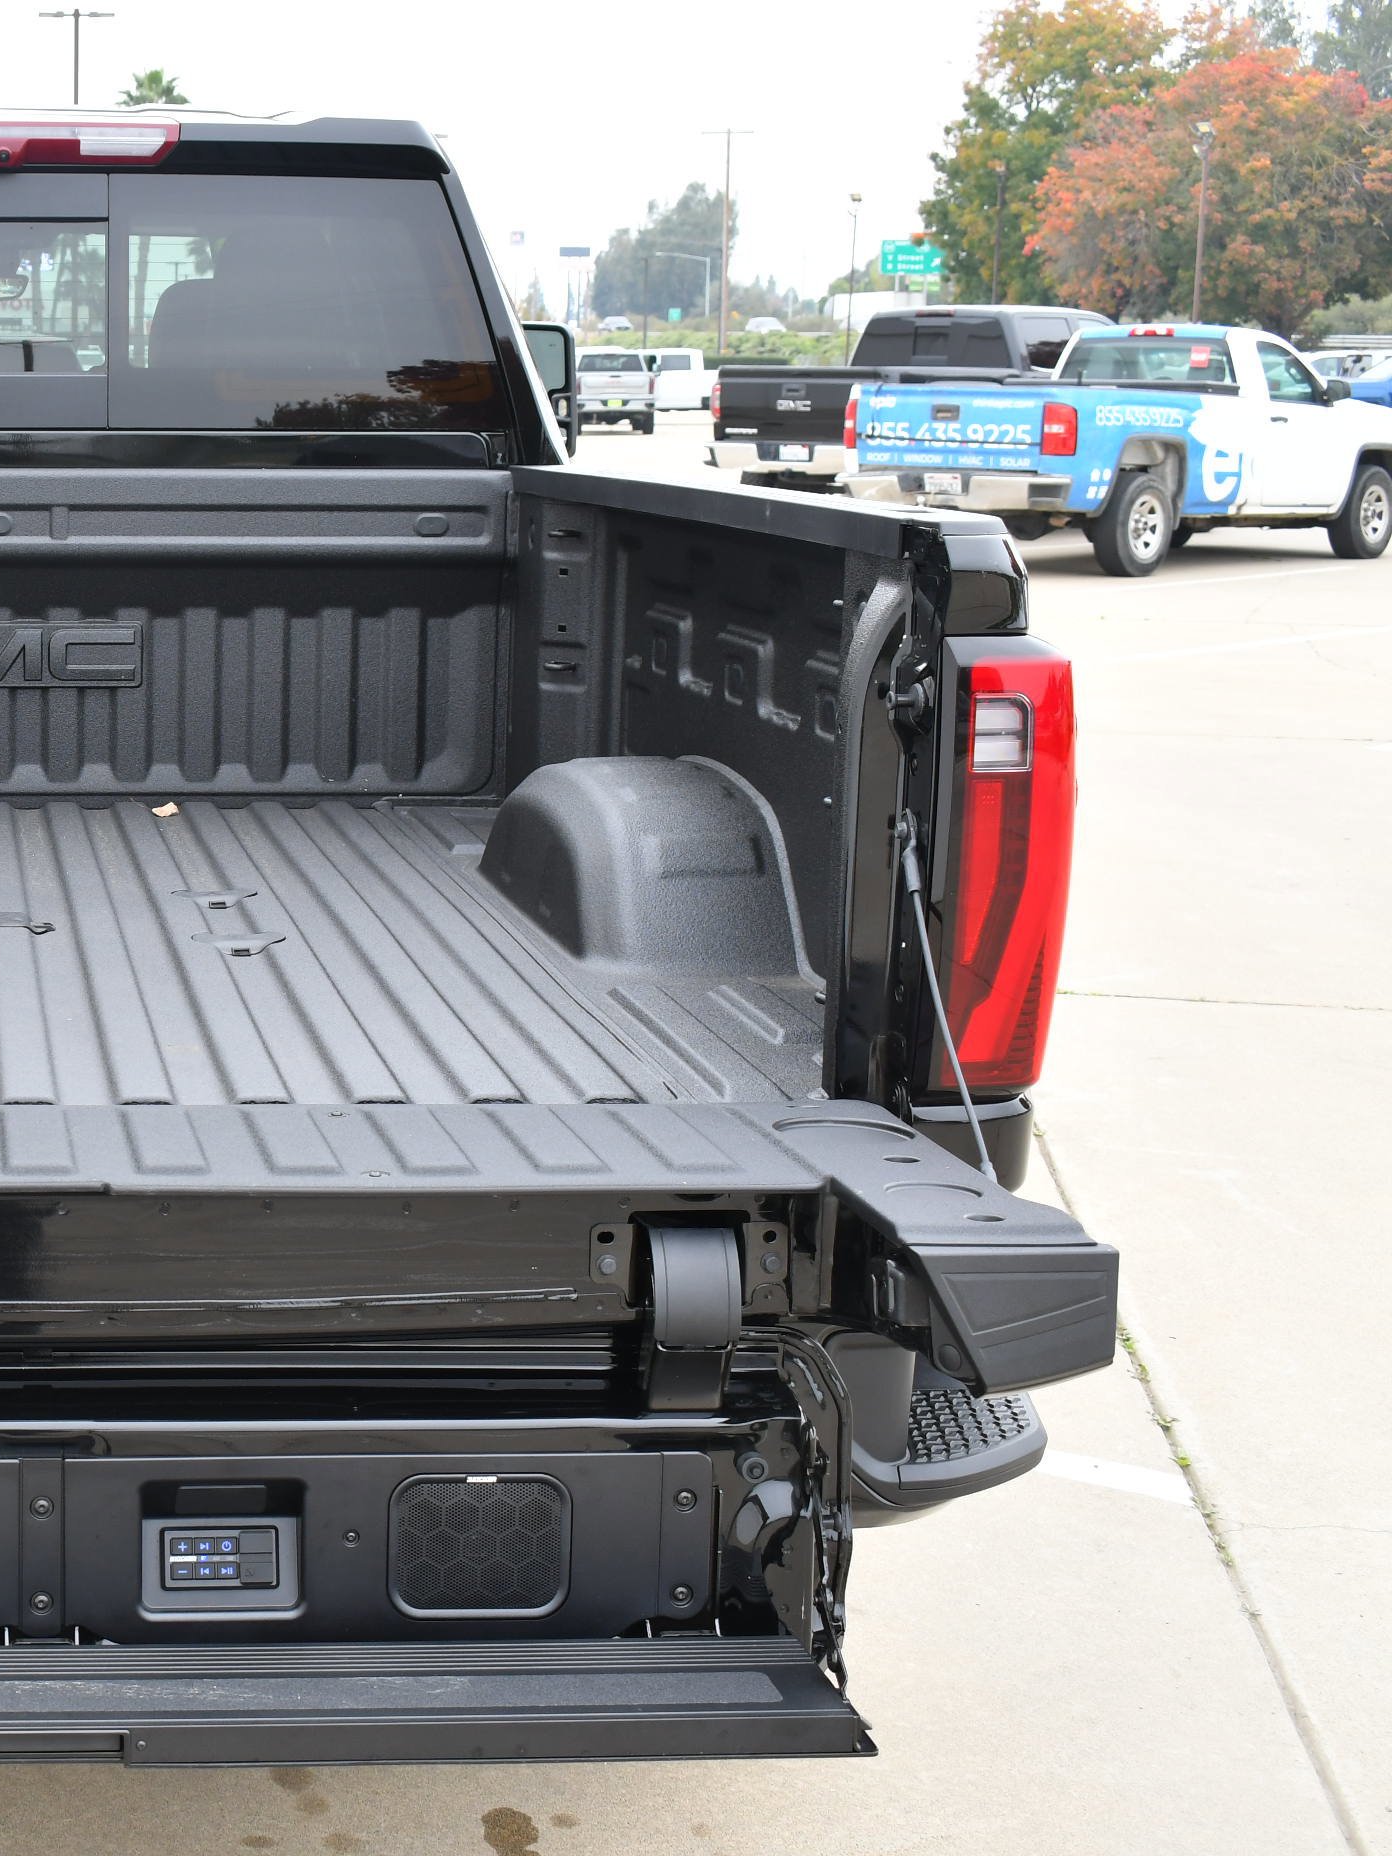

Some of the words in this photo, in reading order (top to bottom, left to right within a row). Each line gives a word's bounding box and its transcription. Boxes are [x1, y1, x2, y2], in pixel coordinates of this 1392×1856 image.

[866, 452, 891, 462] ROOF
[903, 453, 943, 464] WINDOW
[958, 455, 984, 466] HVAC
[999, 456, 1031, 468] SOLAR
